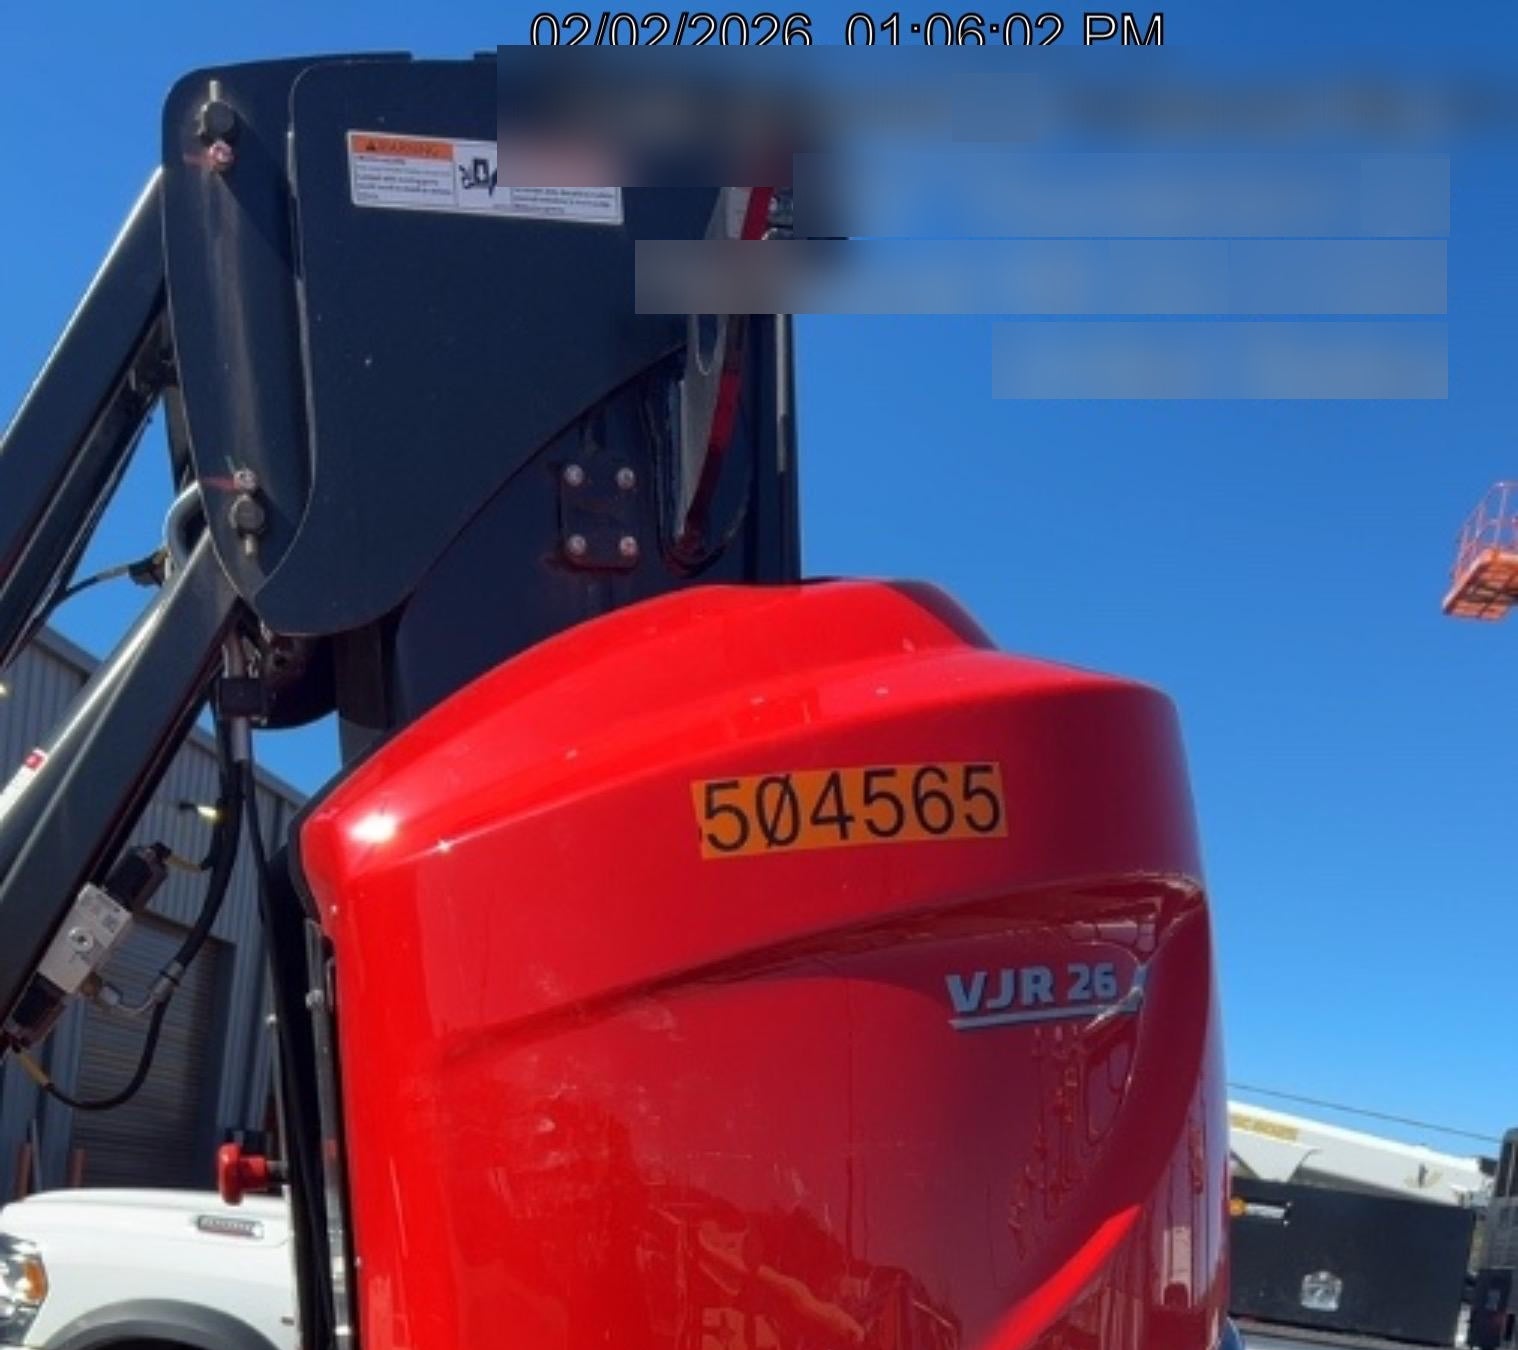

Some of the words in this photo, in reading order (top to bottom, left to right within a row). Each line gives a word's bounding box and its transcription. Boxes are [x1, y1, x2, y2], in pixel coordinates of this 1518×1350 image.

[704, 765, 1001, 852] 504565
[945, 966, 1055, 1013] VJR
[1067, 963, 1118, 1000] 26
